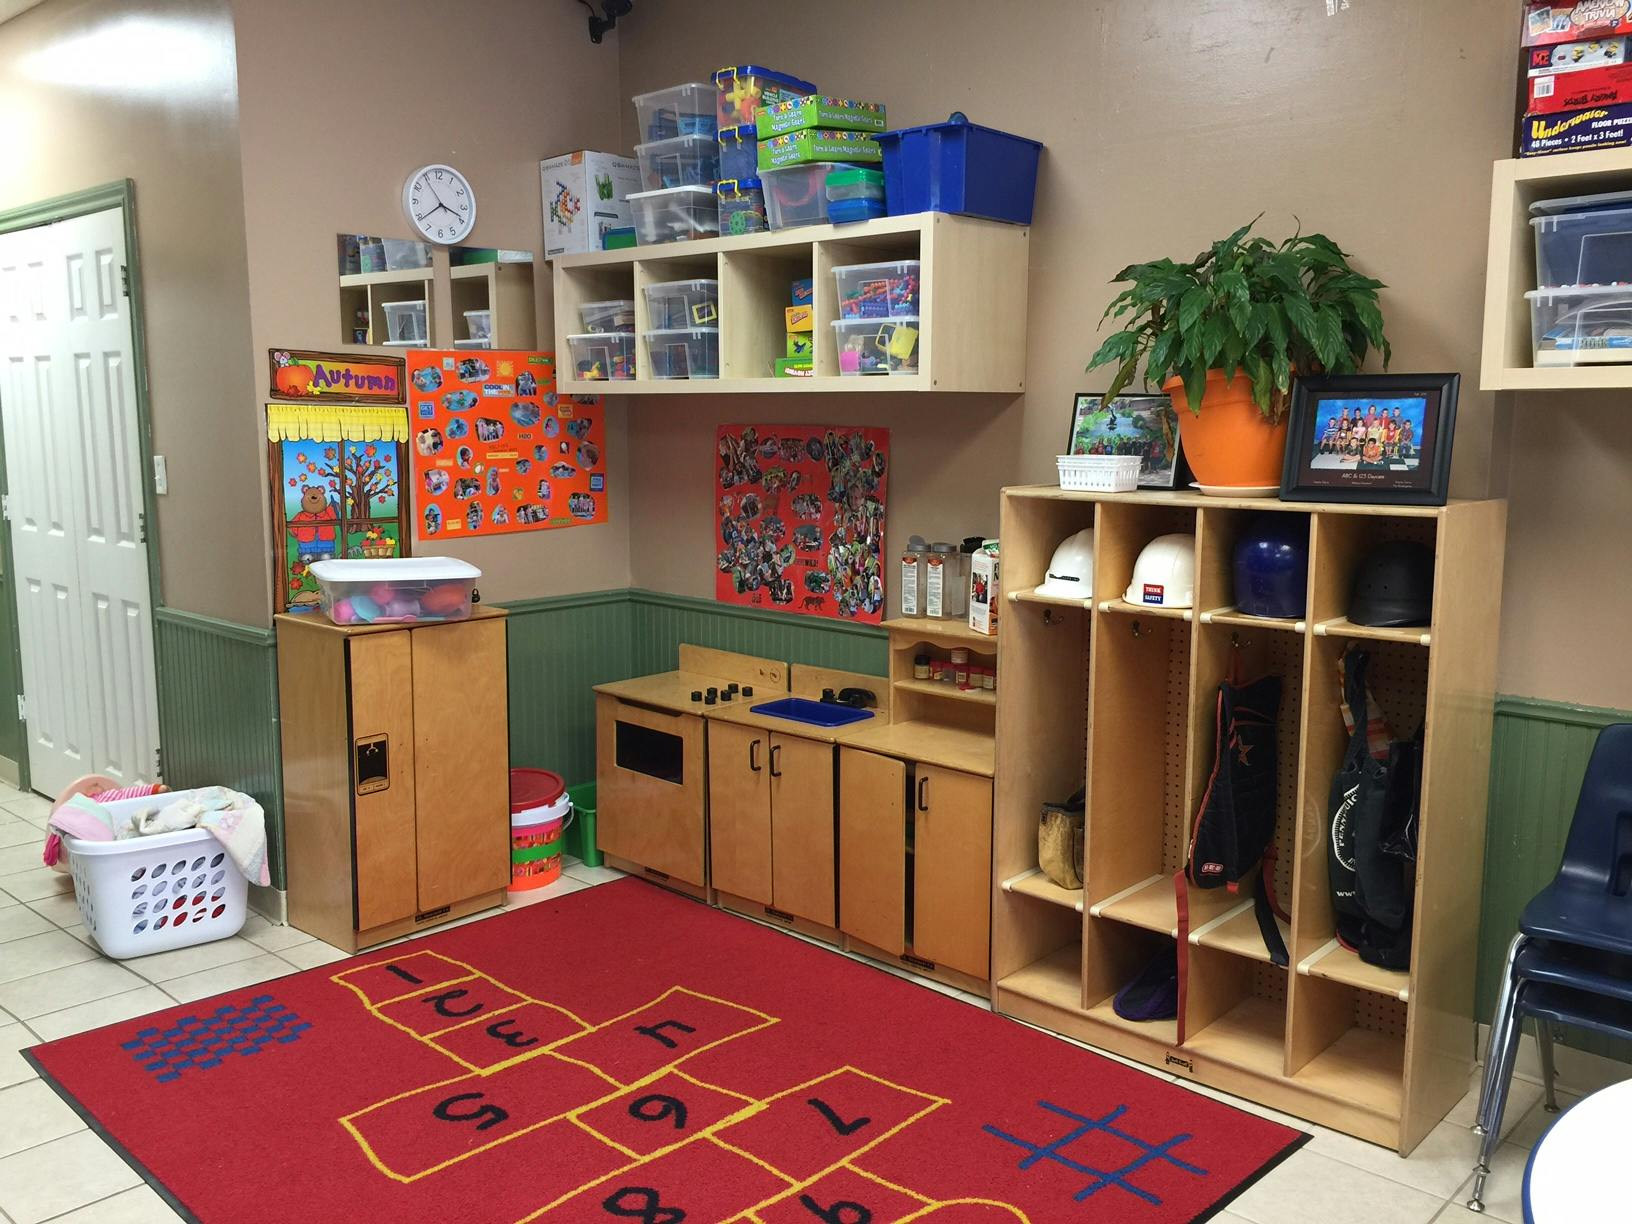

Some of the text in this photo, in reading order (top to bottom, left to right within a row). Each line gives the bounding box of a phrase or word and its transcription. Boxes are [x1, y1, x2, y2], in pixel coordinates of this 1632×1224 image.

[1583, 8, 1616, 21] TRIVIA
[1531, 109, 1608, 139] Underwater
[1591, 120, 1612, 129] FLOOR
[1541, 138, 1562, 147] Pieces
[1577, 133, 1592, 142] Feet
[1606, 129, 1624, 138] Feet!
[435, 171, 443, 180] 12
[414, 182, 422, 192] 10
[456, 189, 464, 197] 2
[416, 213, 423, 221] 8
[425, 224, 432, 232] 7
[438, 229, 443, 238] 6
[449, 226, 456, 236] 5
[313, 364, 396, 391] Autumn
[385, 965, 423, 984] 1
[422, 989, 484, 1017] 2
[486, 1019, 539, 1047] 3
[633, 1020, 697, 1048] 4
[433, 1092, 509, 1131] 5
[807, 1098, 871, 1136] 7
